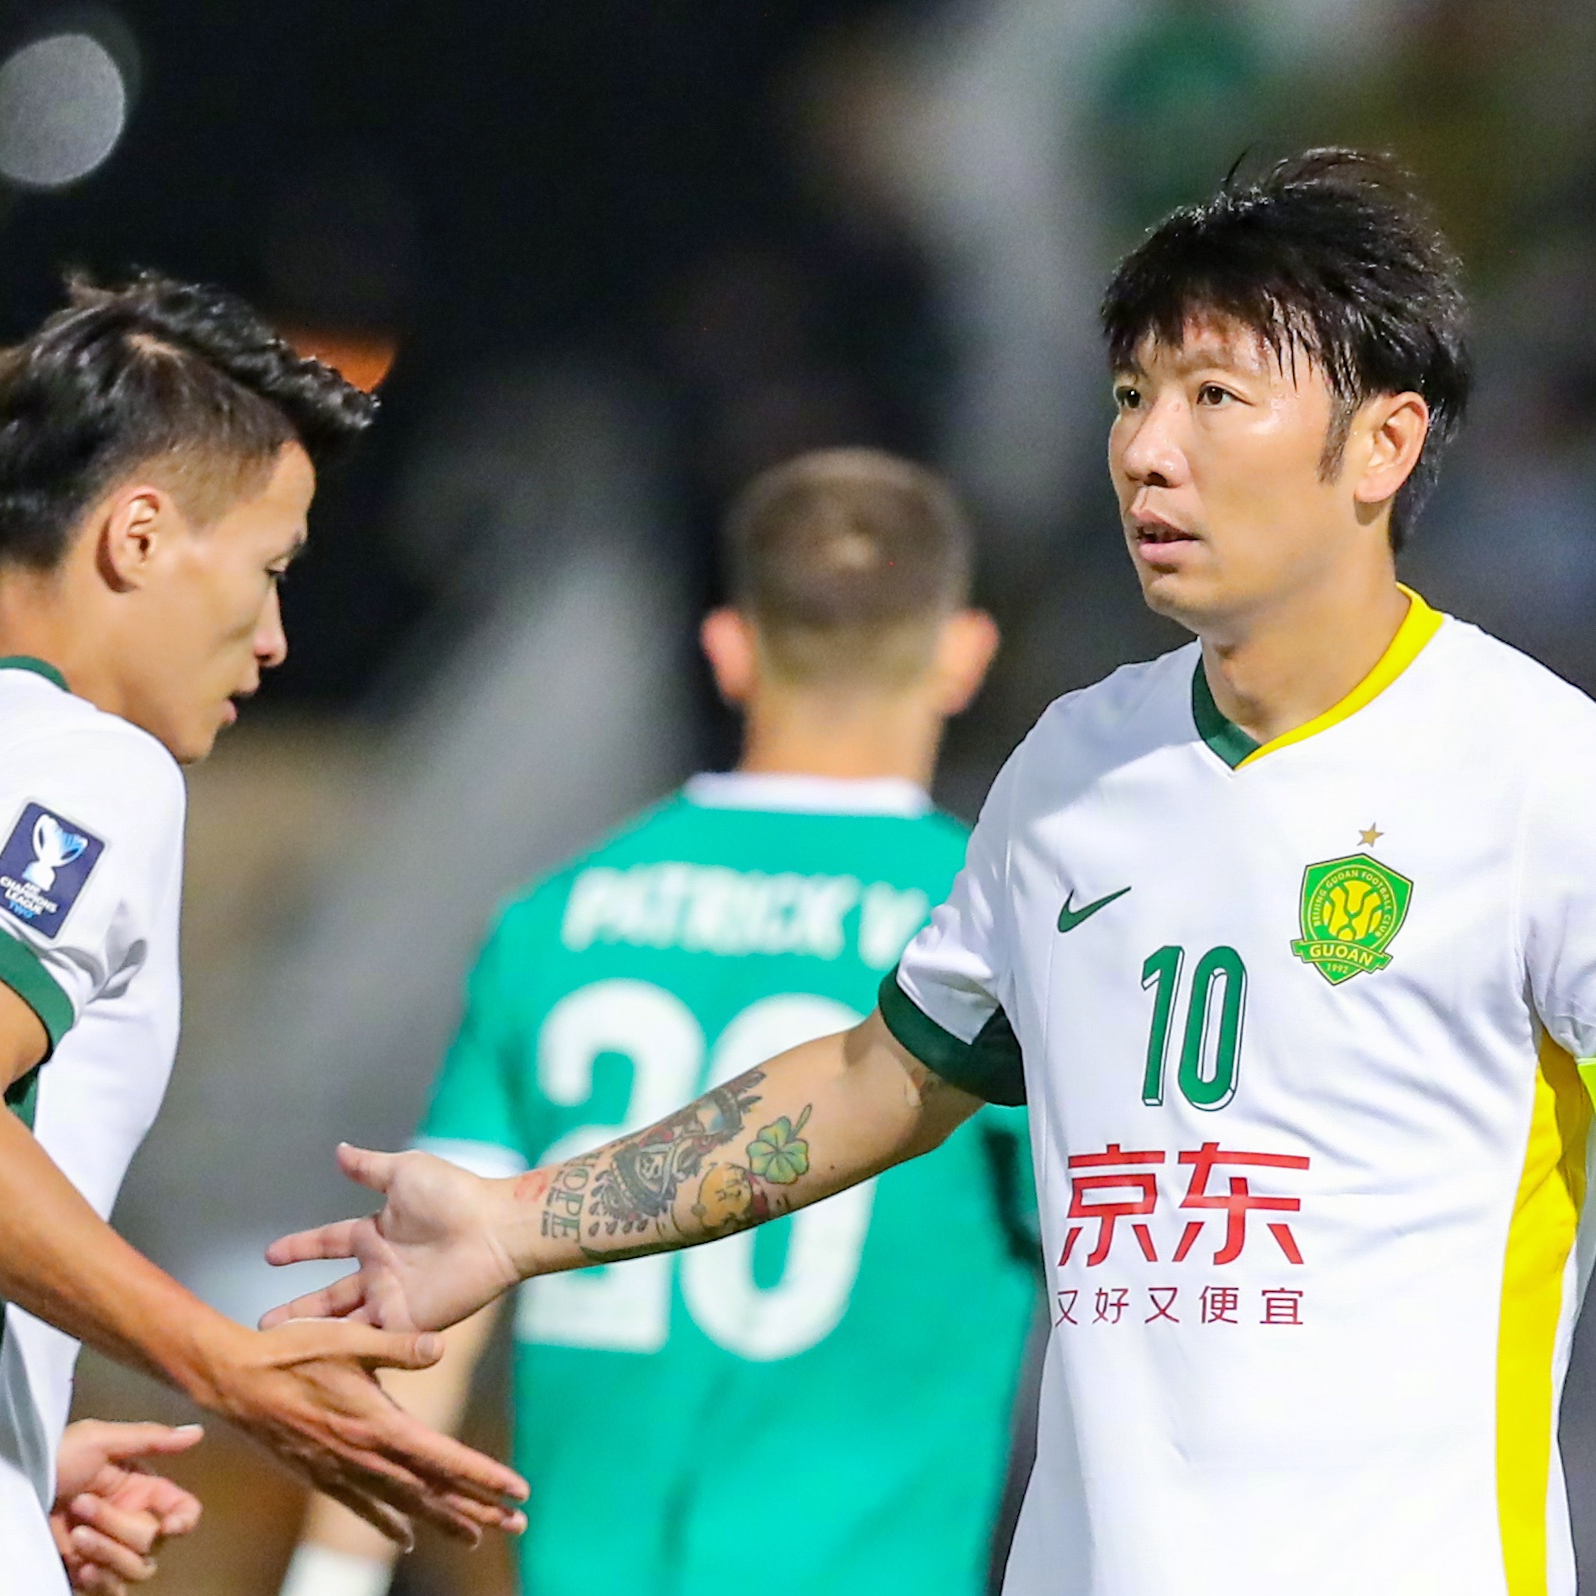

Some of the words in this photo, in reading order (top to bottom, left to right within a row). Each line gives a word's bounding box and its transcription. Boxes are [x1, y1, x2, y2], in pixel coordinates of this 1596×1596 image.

[1325, 870, 1359, 889] GUOAN
[1361, 870, 1392, 911] FOOTBALL
[559, 860, 862, 961] PATRICK
[1312, 889, 1327, 927] BEIJING
[1375, 912, 1392, 938] CLUB
[1310, 944, 1373, 967] GUOAN
[1141, 945, 1248, 1112] 10
[515, 978, 878, 1362] 20
[551, 1152, 601, 1244] HOPE
[1058, 1142, 1310, 1267] 京东
[1055, 1285, 1305, 1328] 又好又便宜
